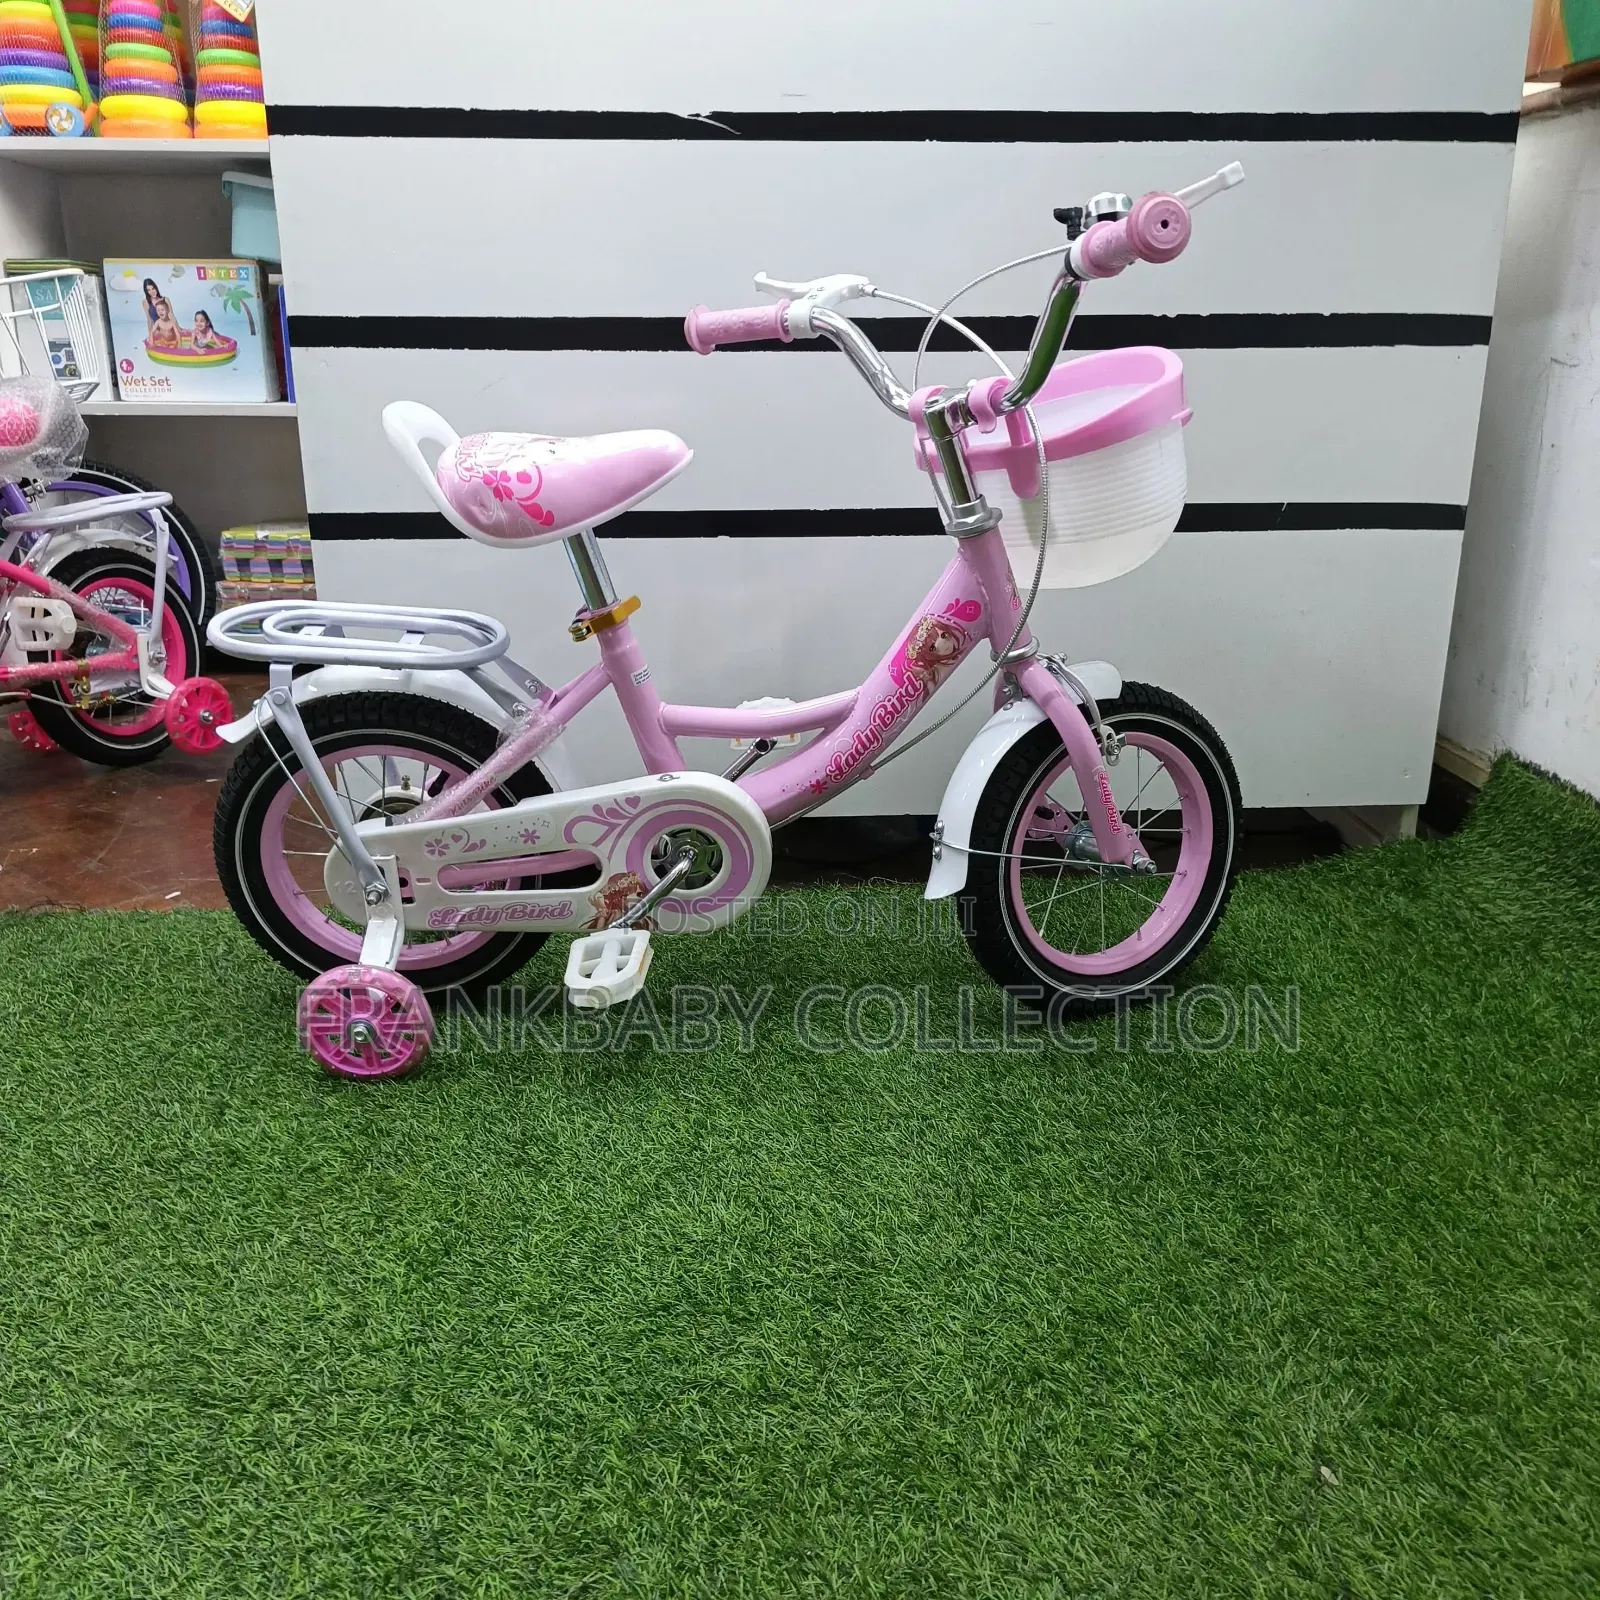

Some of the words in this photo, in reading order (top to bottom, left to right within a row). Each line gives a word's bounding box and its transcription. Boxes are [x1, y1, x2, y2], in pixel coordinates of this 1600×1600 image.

[198, 267, 249, 279] INTEX
[120, 375, 147, 387] Wet
[149, 375, 172, 387] Set
[825, 724, 883, 783] Lady
[870, 670, 924, 732] Bird
[1098, 771, 1113, 806] Lady
[1106, 804, 1122, 836] Bird
[334, 880, 357, 893] 12
[427, 904, 502, 929] Lady
[501, 900, 574, 921] Bird
